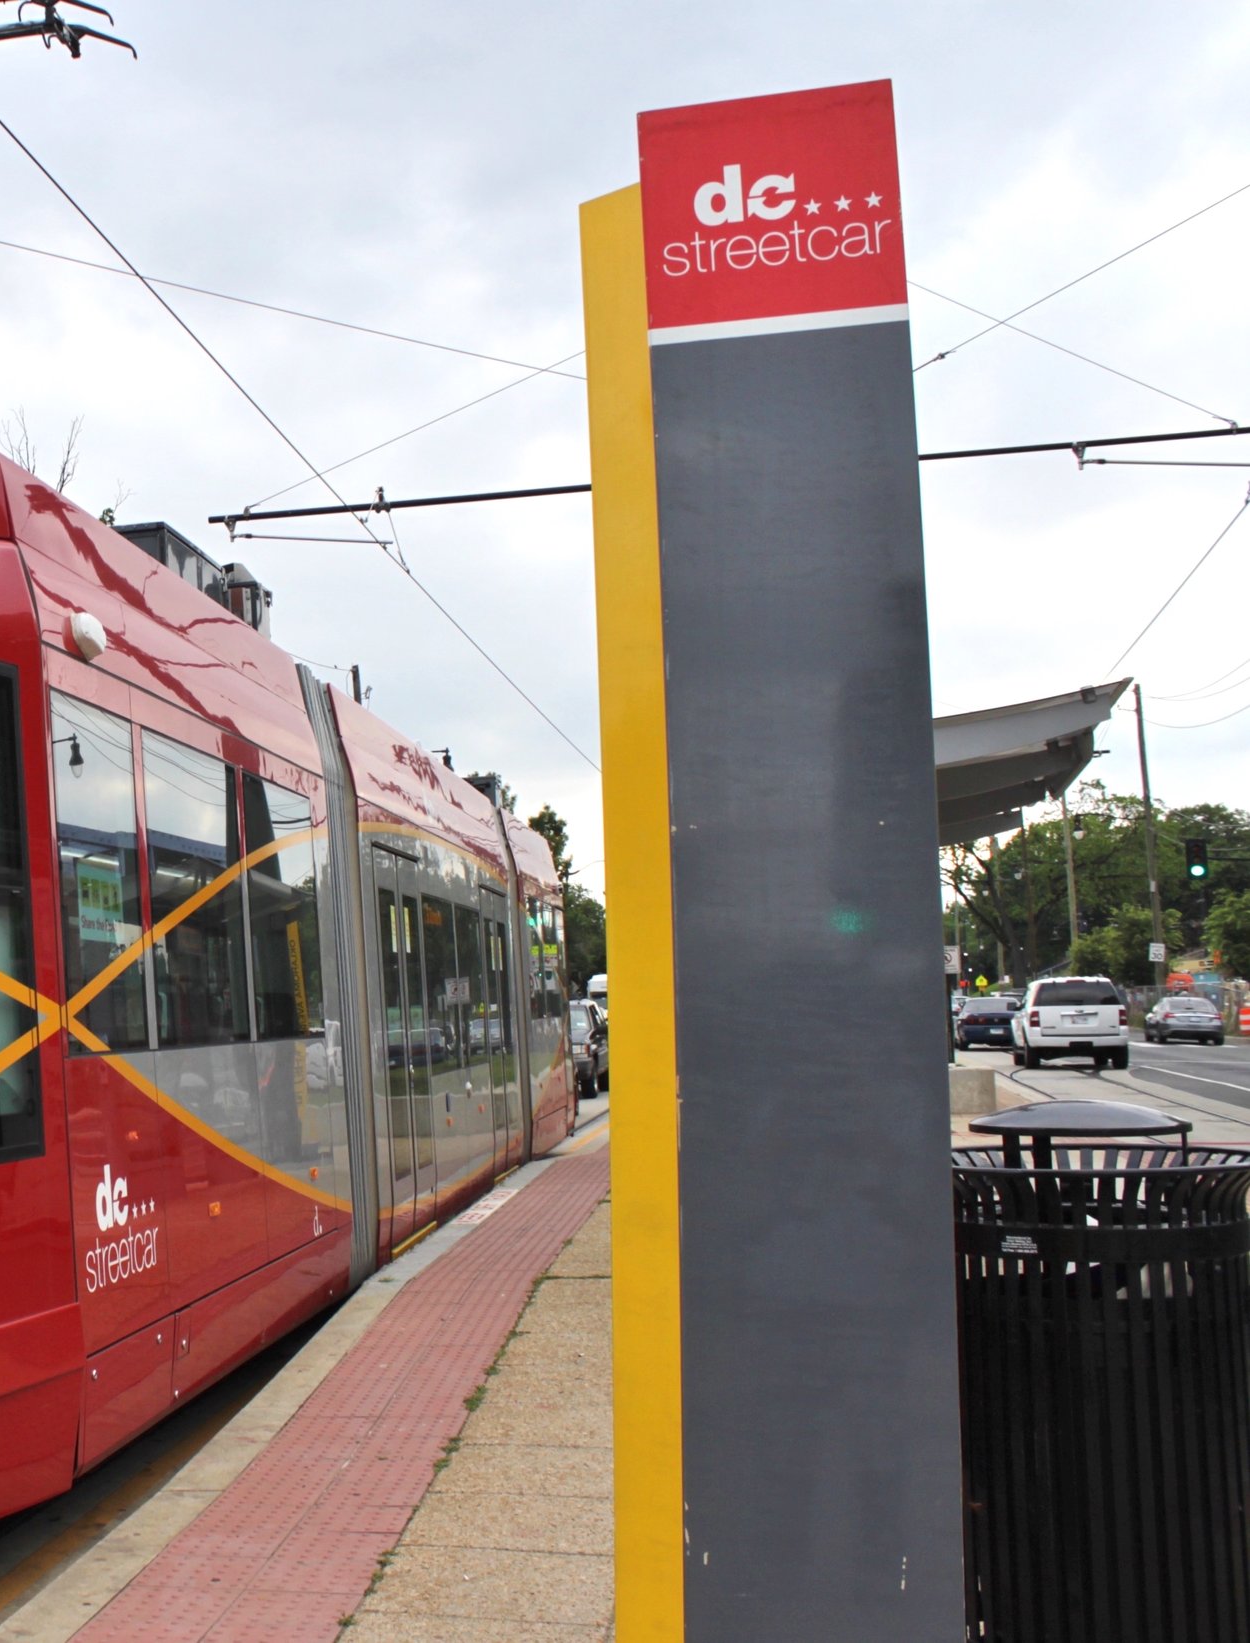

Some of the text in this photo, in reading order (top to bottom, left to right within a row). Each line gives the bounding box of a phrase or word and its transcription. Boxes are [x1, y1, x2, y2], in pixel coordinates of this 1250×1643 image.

[693, 164, 796, 227] dc
[662, 219, 892, 277] streetcar
[1151, 952, 1163, 960] 30
[95, 1163, 129, 1232] dc
[85, 1226, 159, 1293] streetcar
